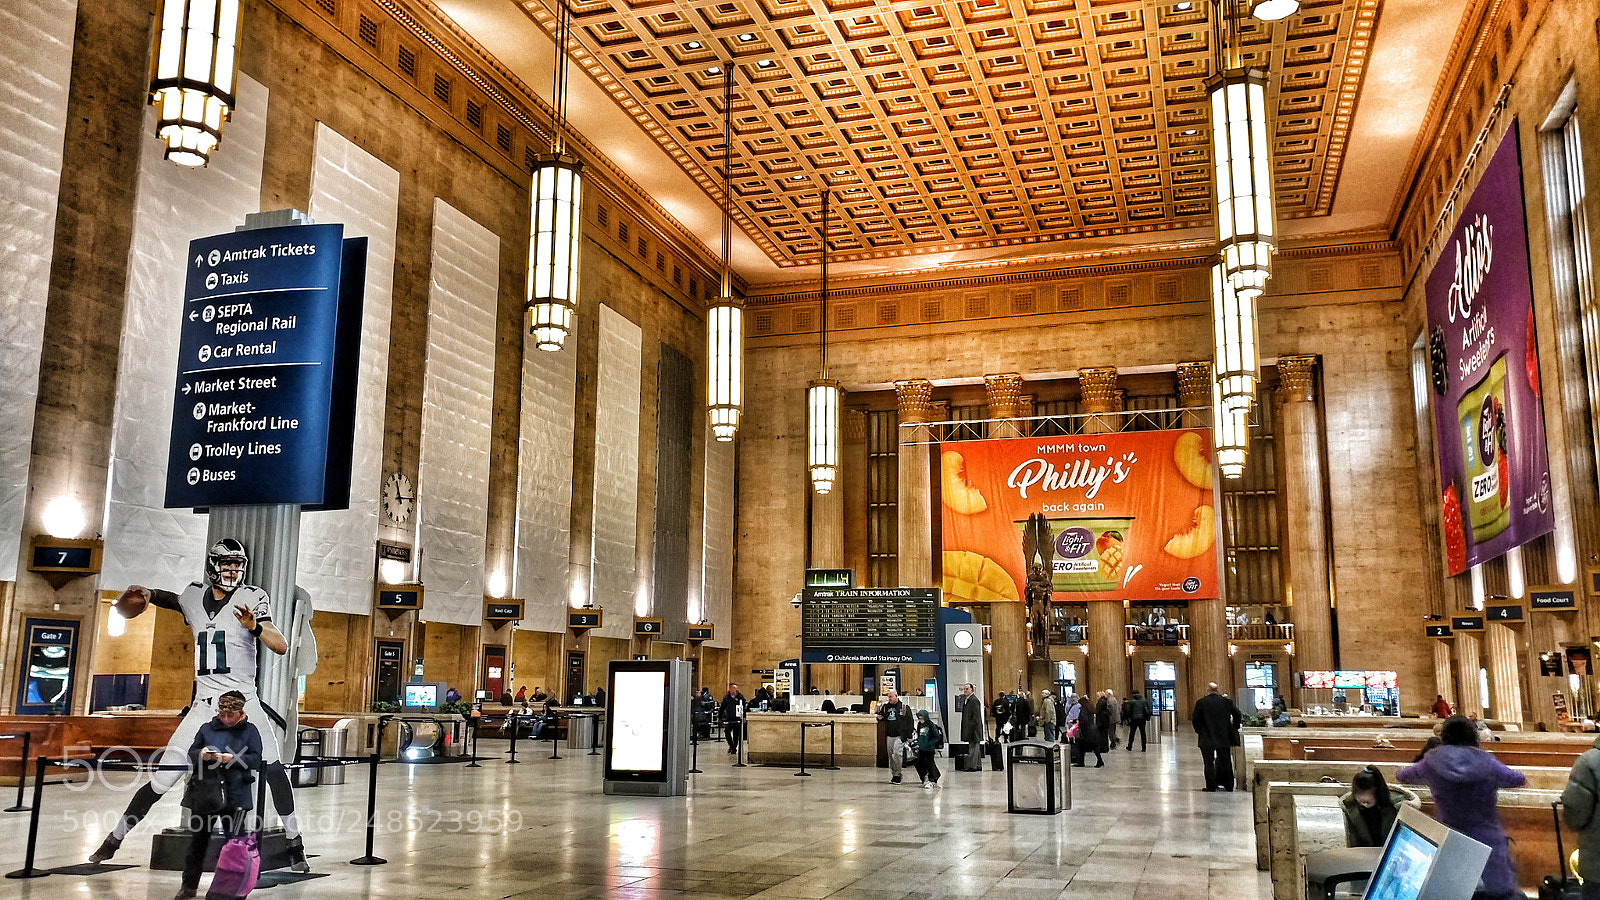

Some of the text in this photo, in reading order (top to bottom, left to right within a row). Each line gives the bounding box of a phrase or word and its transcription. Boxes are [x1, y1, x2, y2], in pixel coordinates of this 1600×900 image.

[222, 243, 316, 263] Amtrak Tickets
[220, 270, 249, 286] Taxis
[217, 302, 253, 318] SEPTA
[215, 315, 297, 337] Regional Rail
[213, 340, 277, 359] Car Rental
[194, 376, 277, 394] Market Street
[208, 401, 256, 417] Market-
[206, 415, 299, 433] Frankford Line
[204, 441, 282, 459] Trolley Lines
[1037, 443, 1106, 455] MMMM town
[202, 468, 236, 483] Buses
[1007, 456, 1131, 499] Philly's
[1473, 475, 1492, 499] ZERO
[1042, 501, 1105, 513] back again
[1062, 534, 1084, 547] Light
[1069, 542, 1091, 554] FIT
[58, 551, 68, 564] 7
[1052, 562, 1073, 571] ERO
[395, 594, 402, 604] 5
[581, 616, 587, 624] 3
[1500, 609, 1507, 618] 4
[41, 632, 57, 640] Gate
[1436, 627, 1443, 635] 2
[197, 630, 231, 676] 11
[878, 655, 901, 663] Stairway
